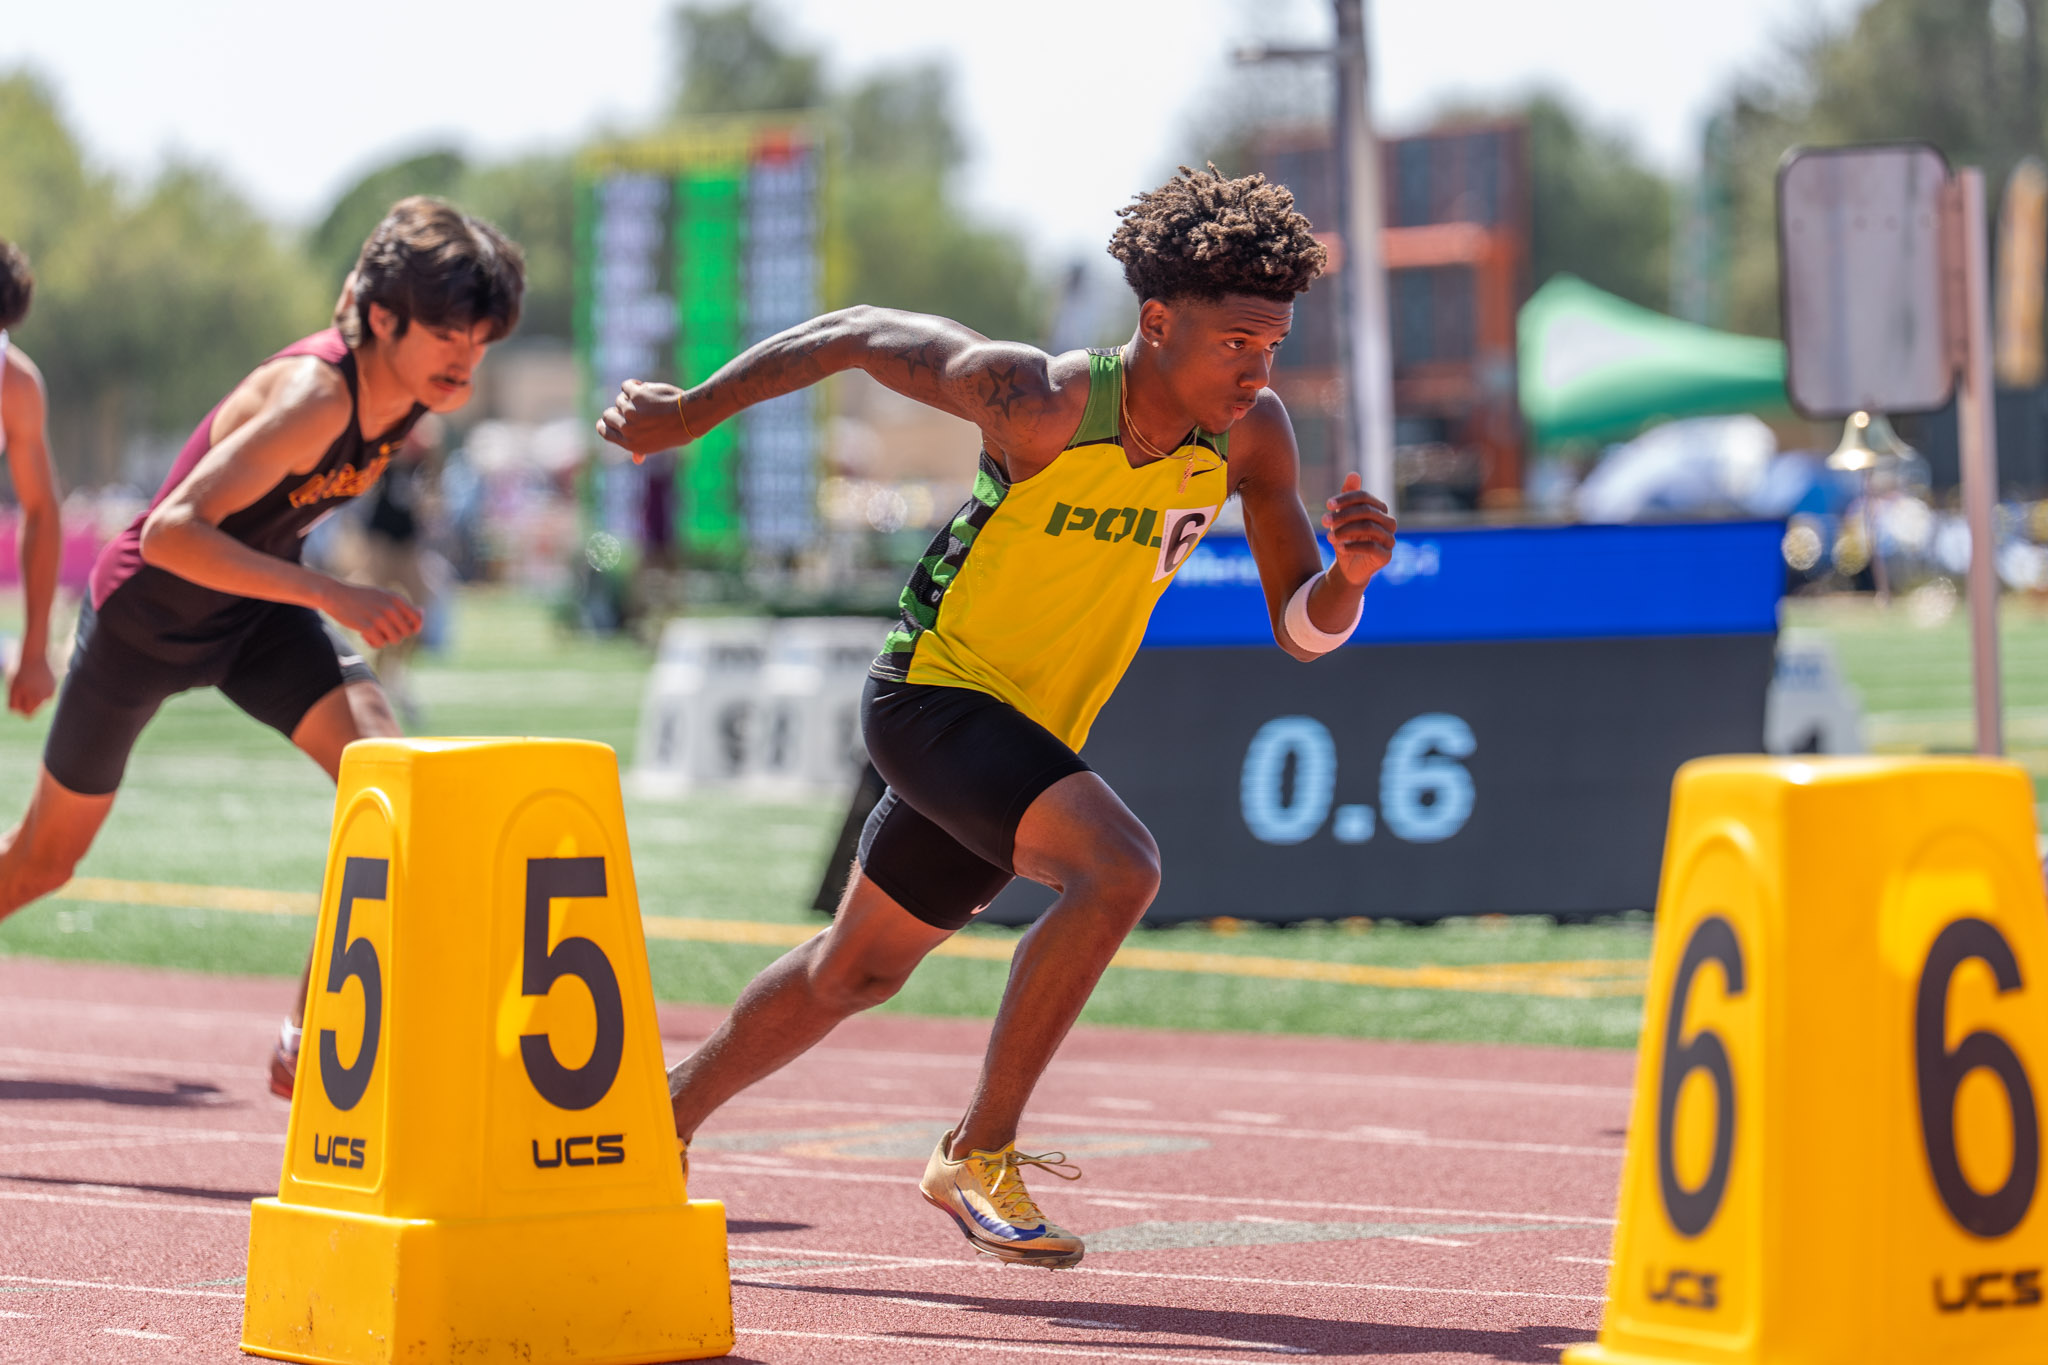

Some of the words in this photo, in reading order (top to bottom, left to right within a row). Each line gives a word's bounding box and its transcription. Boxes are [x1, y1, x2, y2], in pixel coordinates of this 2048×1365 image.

[1164, 512, 1206, 573] 6
[1240, 713, 1478, 845] 0.6
[319, 856, 389, 1111] 5
[519, 856, 624, 1111] 5
[1658, 914, 1746, 1240] 6
[1912, 917, 2040, 1241] 6
[314, 1133, 366, 1169] UCS
[532, 1134, 626, 1169] UCS
[1647, 1266, 1720, 1310] UCS
[1933, 1268, 2043, 1313] UCS
